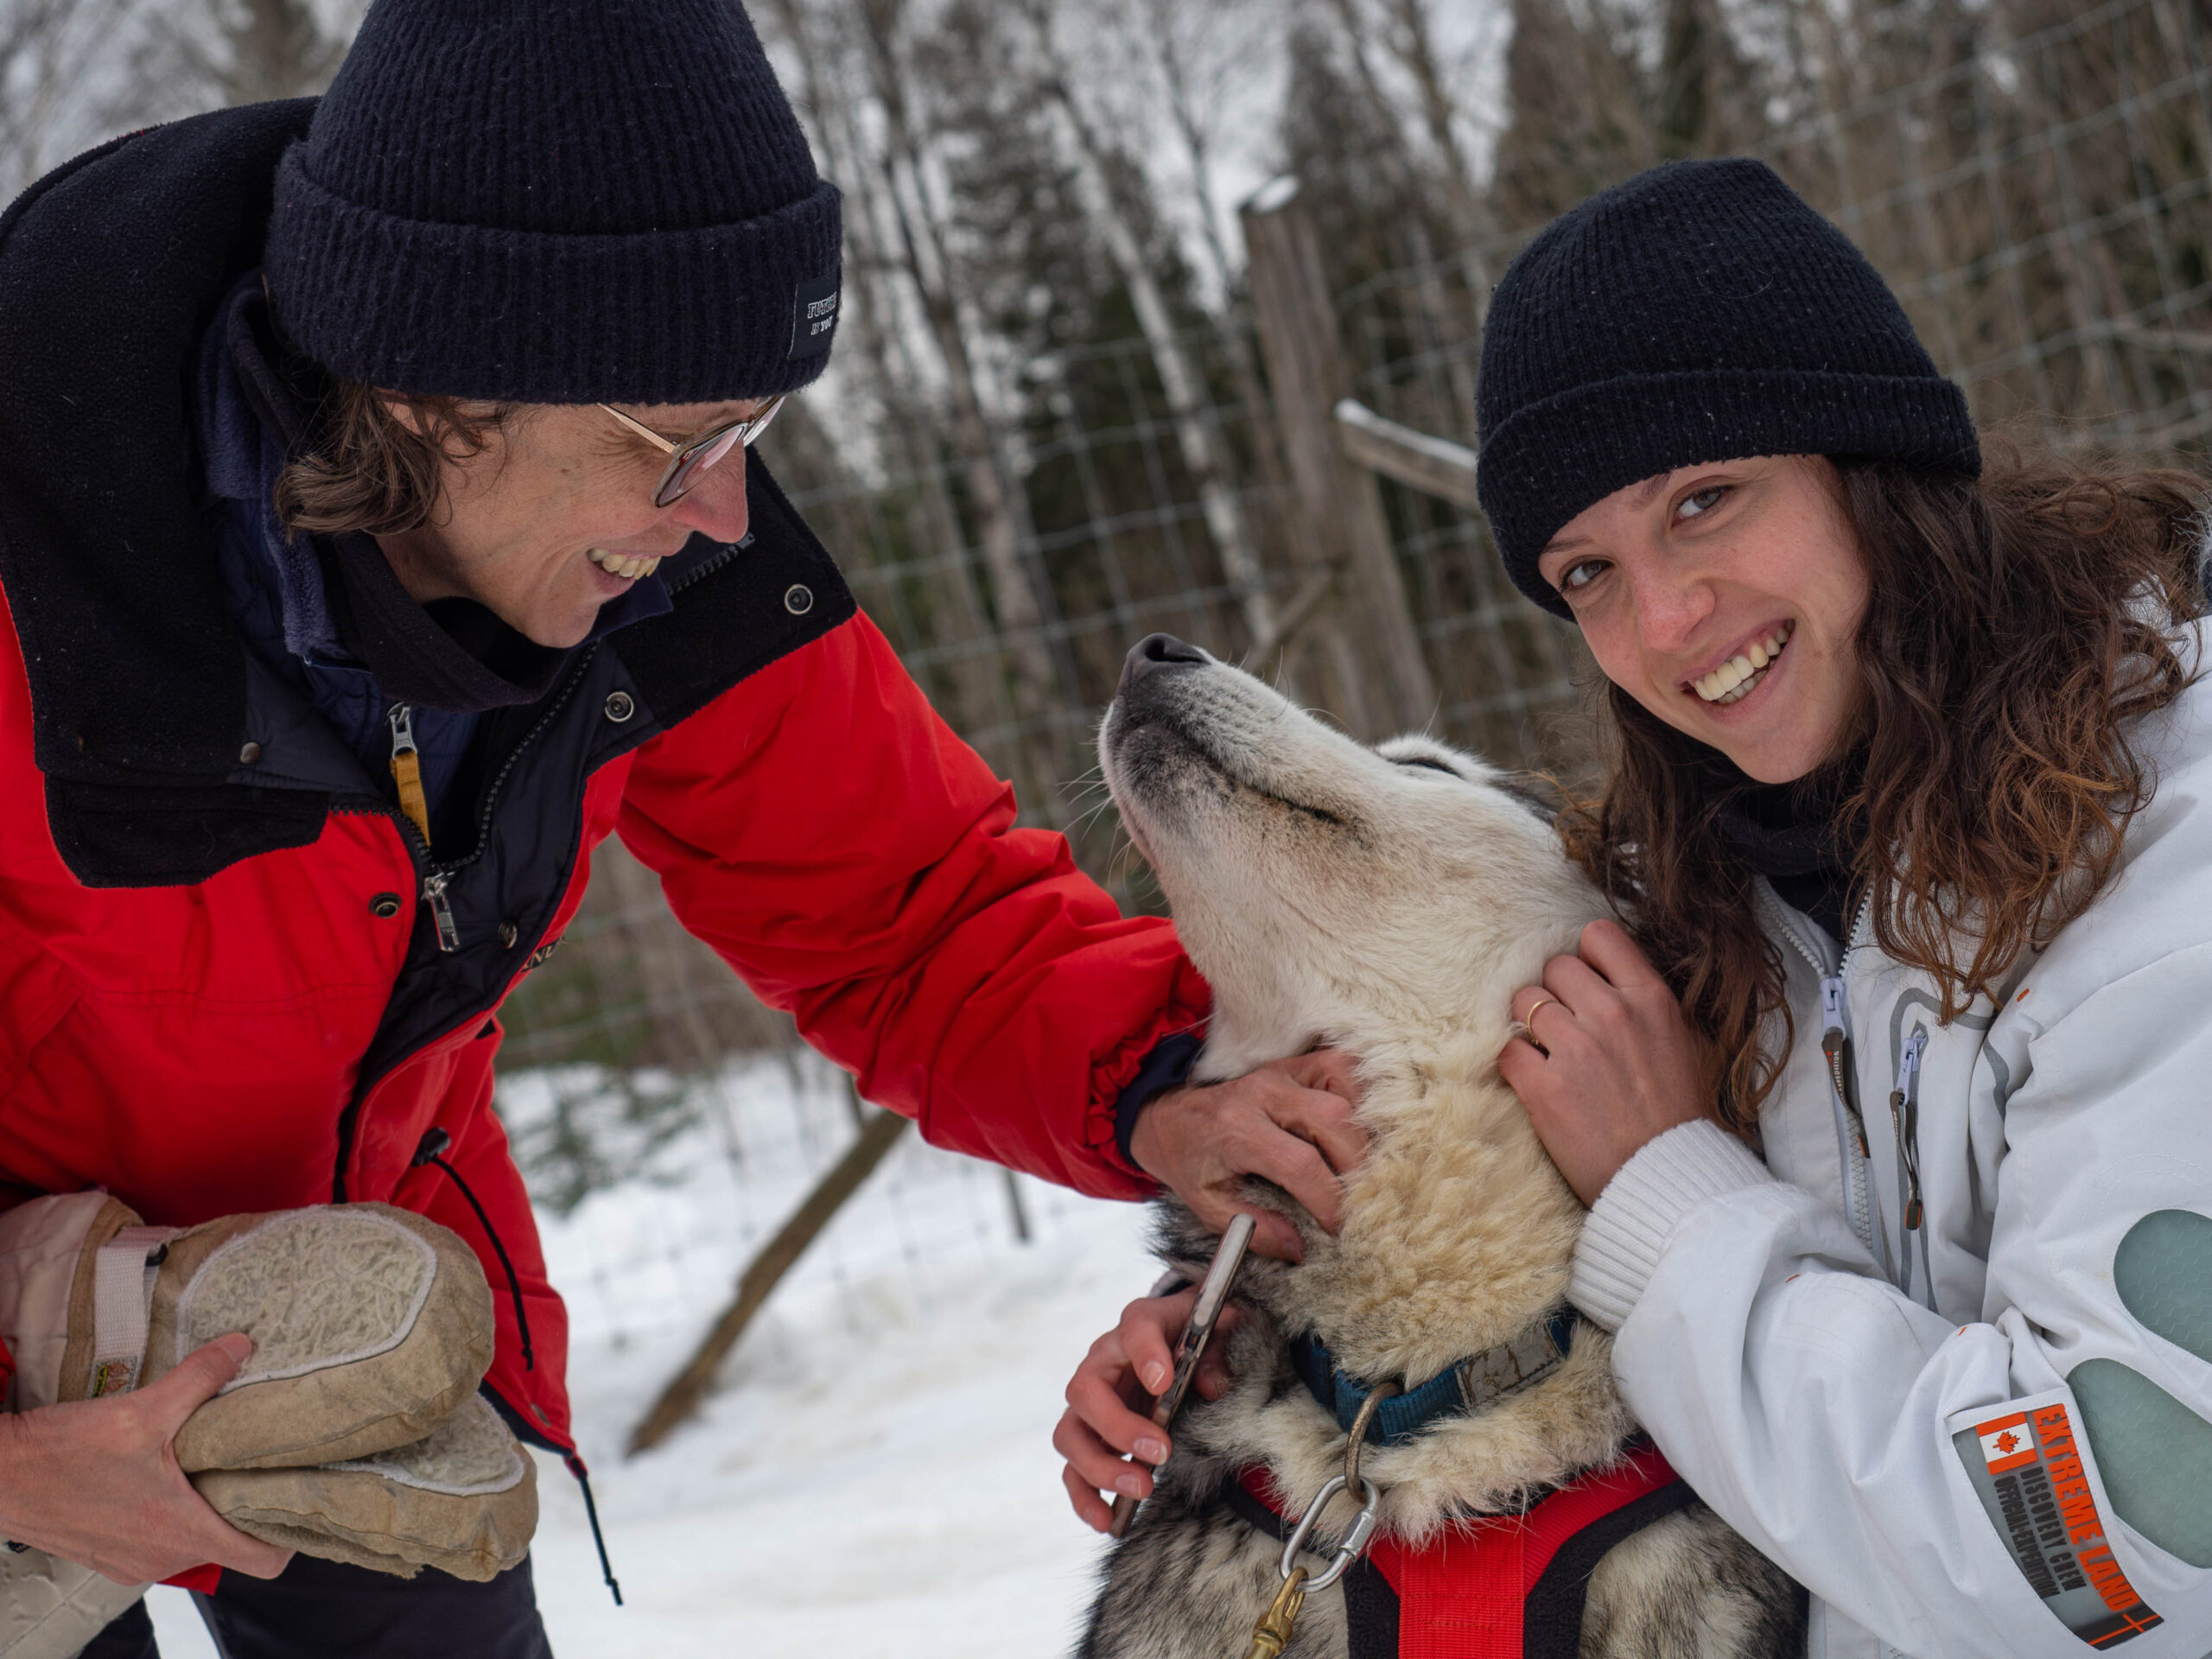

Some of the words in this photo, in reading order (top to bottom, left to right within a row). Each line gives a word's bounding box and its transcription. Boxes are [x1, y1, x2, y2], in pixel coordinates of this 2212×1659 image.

[1993, 1475, 2030, 1532] OFFICIAL
[2012, 1529, 2061, 1599] EXPEDITION
[2020, 1466, 2067, 1549] DISCOVERY
[2049, 1552, 2087, 1592] CREW
[2033, 1403, 2103, 1545] EXTREME
[2077, 1544, 2140, 1611] LAND
